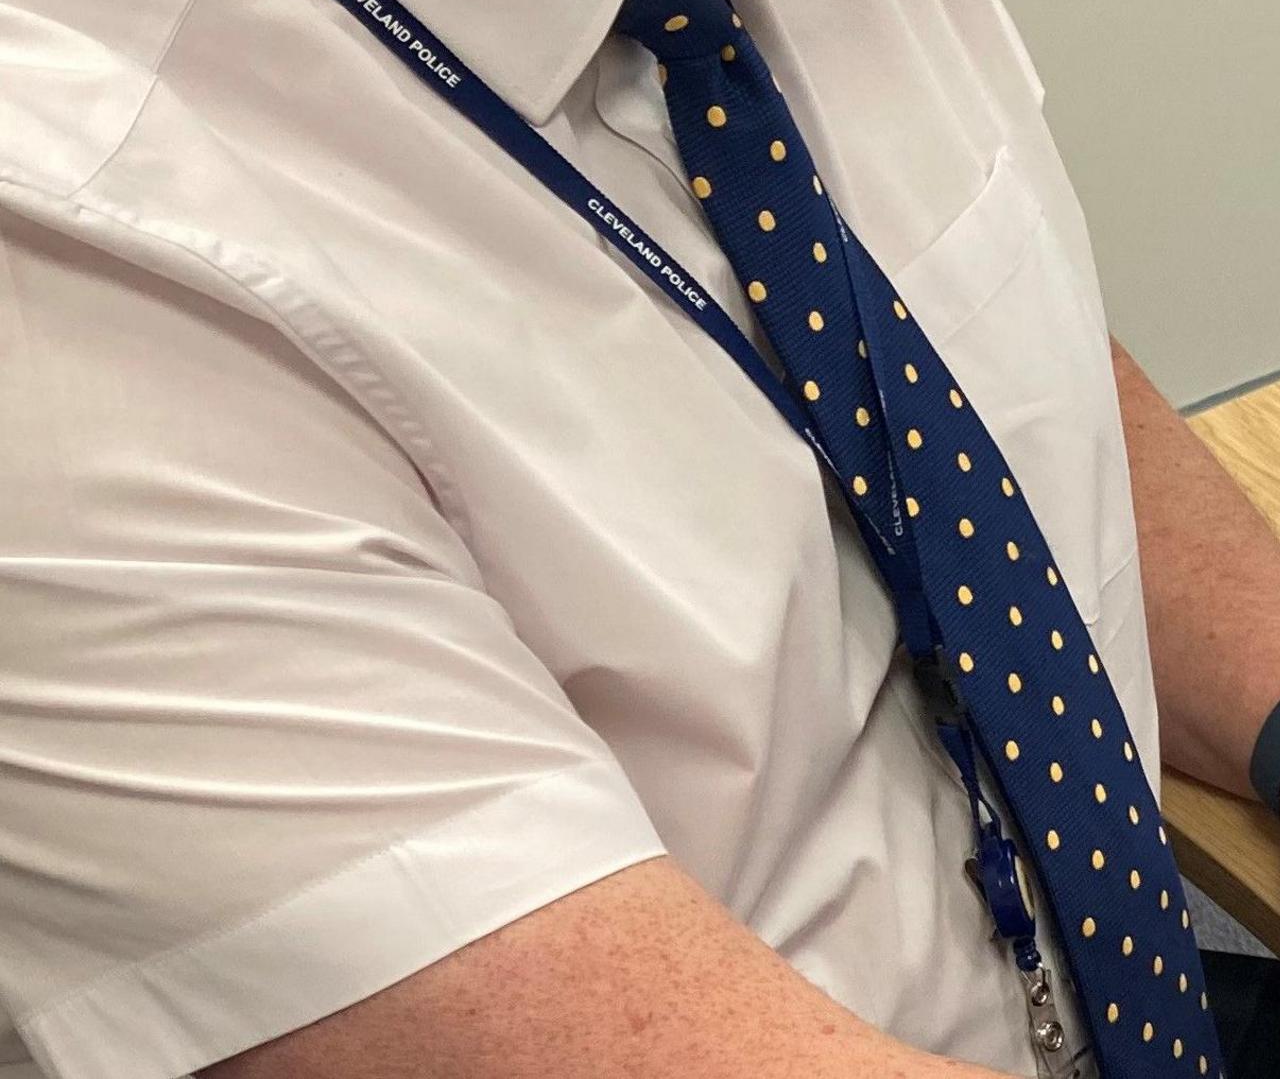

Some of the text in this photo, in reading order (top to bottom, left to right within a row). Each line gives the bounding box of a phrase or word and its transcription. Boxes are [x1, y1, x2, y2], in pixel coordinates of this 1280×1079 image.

[409, 41, 462, 88] POLICE
[587, 197, 708, 311] CLEVELAND POLICE
